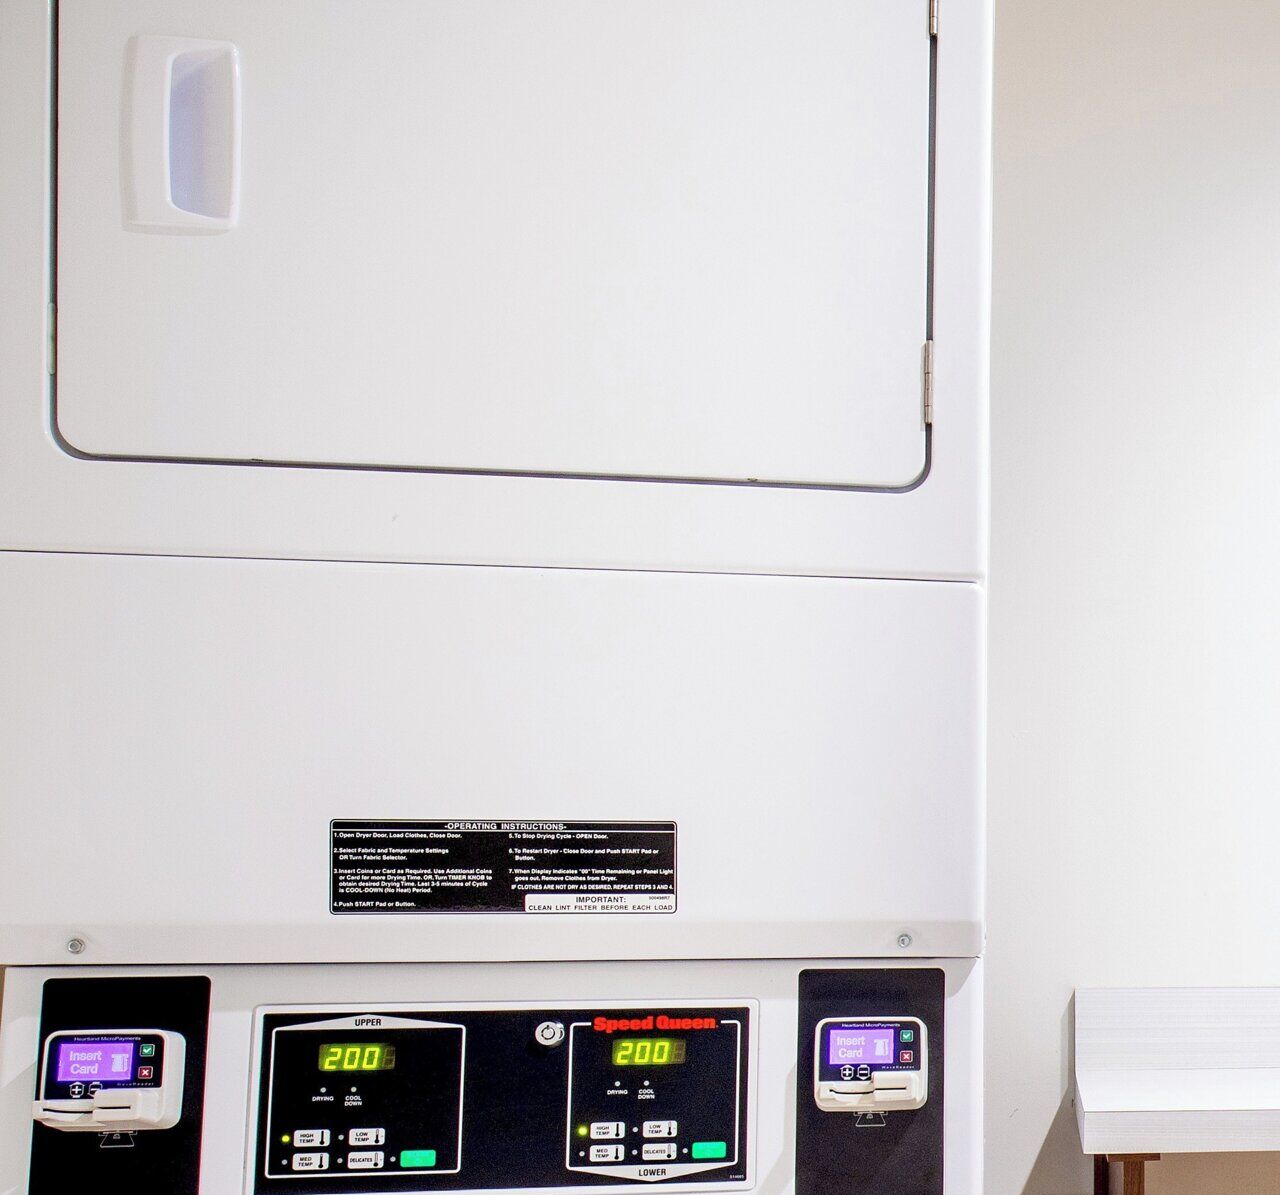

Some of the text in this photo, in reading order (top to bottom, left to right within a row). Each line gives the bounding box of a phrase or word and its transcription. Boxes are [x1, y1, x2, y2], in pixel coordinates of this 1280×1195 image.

[594, 1015, 716, 1033] Speed Queen
[837, 1036, 865, 1045] Insert
[70, 1051, 102, 1061] Insert
[617, 1042, 669, 1063] 200
[839, 1048, 862, 1057] Card
[325, 1048, 379, 1069] 200
[71, 1064, 97, 1074] Card
